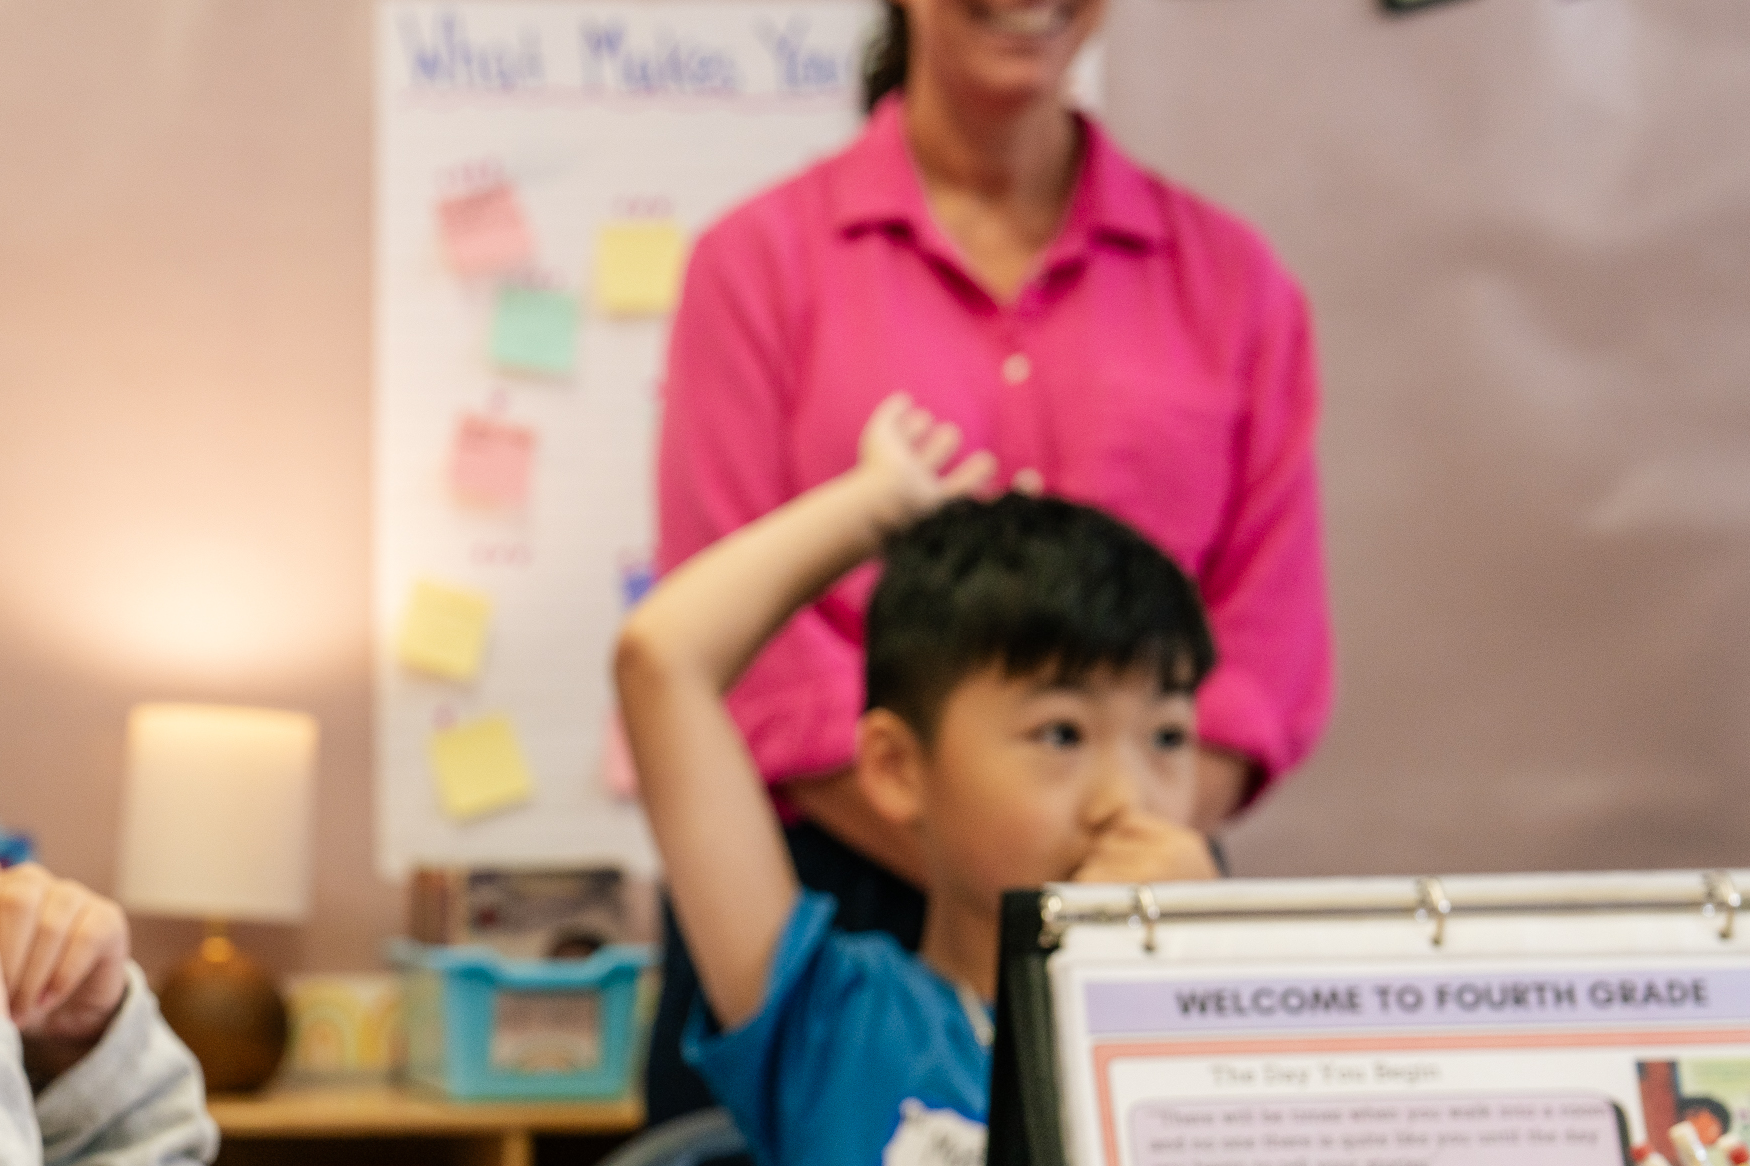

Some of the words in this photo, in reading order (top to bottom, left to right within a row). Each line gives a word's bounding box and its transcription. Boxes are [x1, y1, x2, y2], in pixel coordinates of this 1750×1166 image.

[1174, 985, 1361, 1019] WELCOME
[1375, 983, 1425, 1014] TO
[1434, 980, 1577, 1012] FOURTH
[1588, 977, 1708, 1008] GRADE
[1208, 1062, 1256, 1087] The
[1261, 1062, 1310, 1087] Day
[1319, 1061, 1367, 1085] You
[1371, 1059, 1440, 1085] Begin
